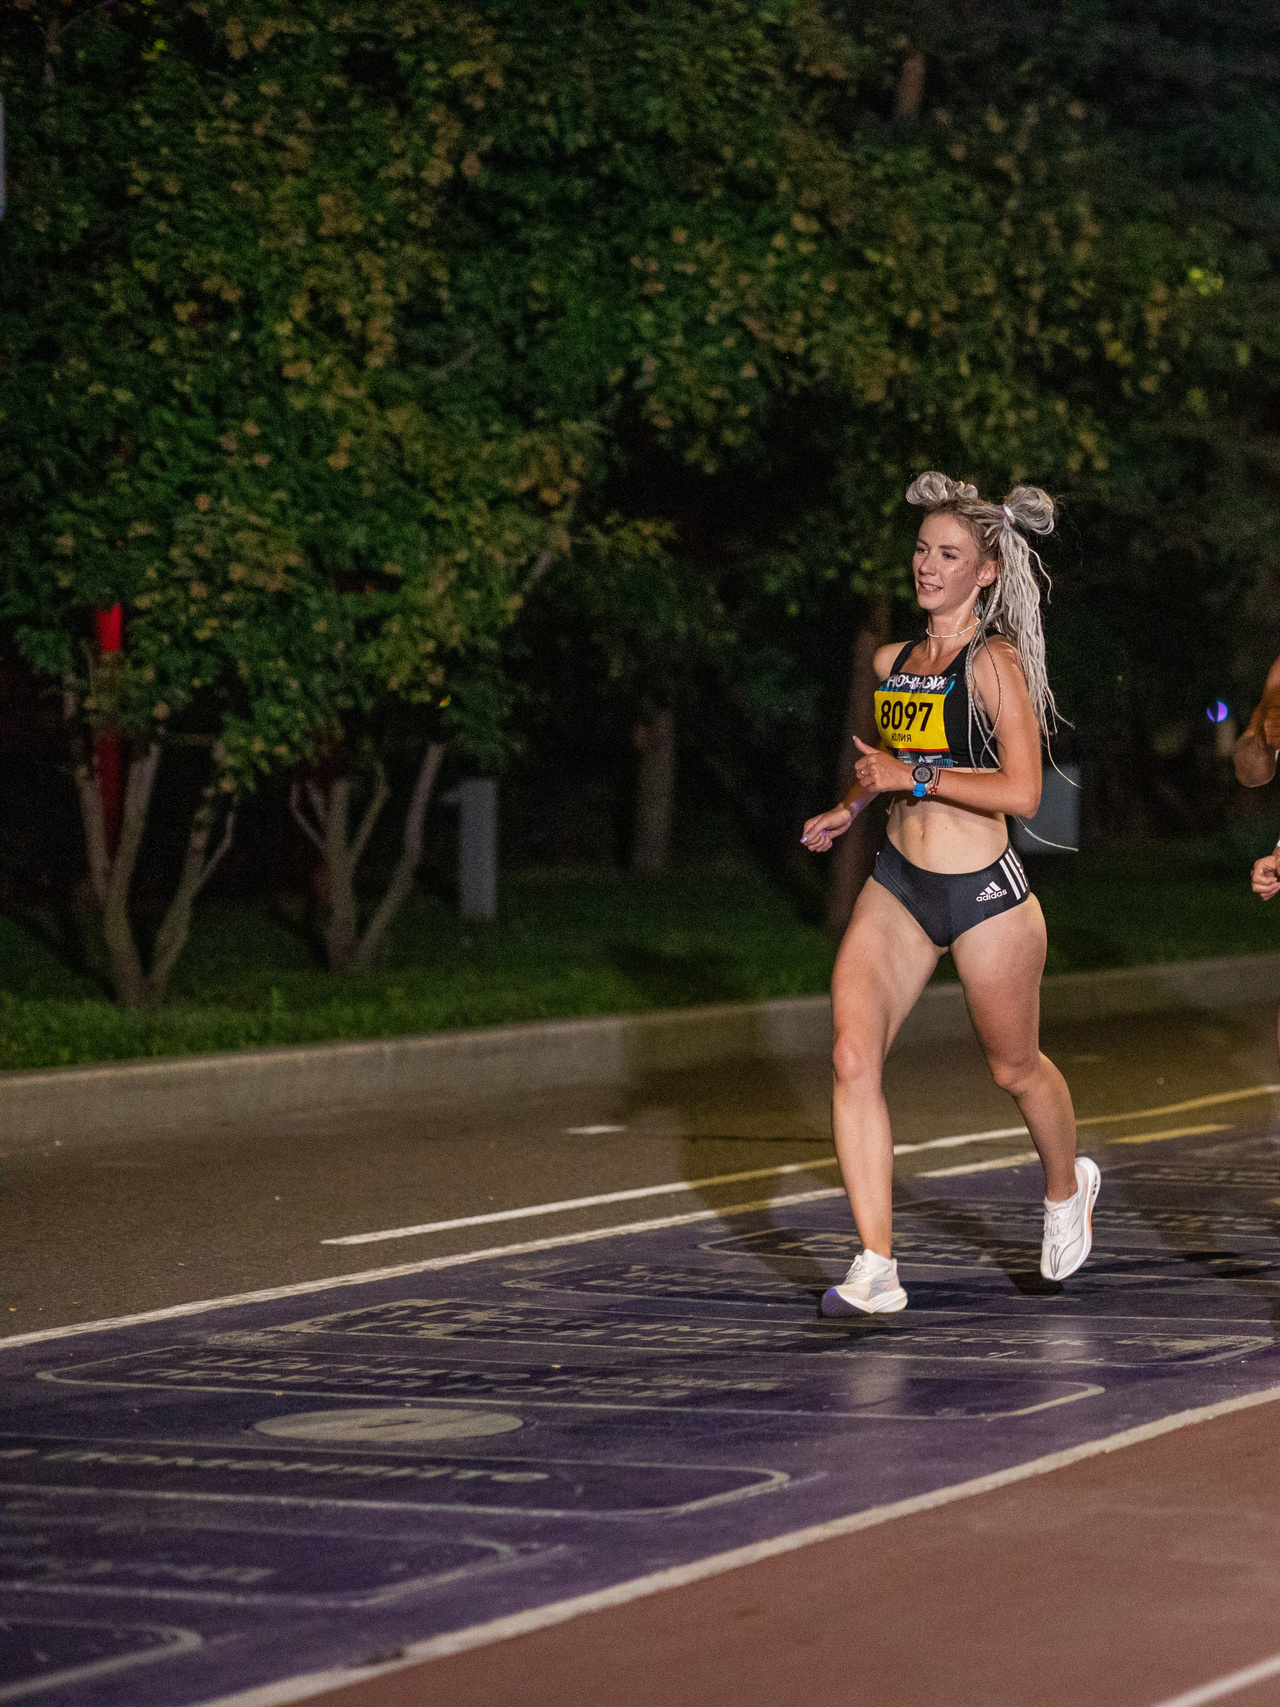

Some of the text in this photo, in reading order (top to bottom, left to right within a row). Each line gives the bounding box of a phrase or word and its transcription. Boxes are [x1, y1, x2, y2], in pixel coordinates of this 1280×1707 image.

[881, 700, 933, 730] 8097
[892, 734, 911, 746] ЮЛИЯ
[976, 889, 1007, 901] adidas
